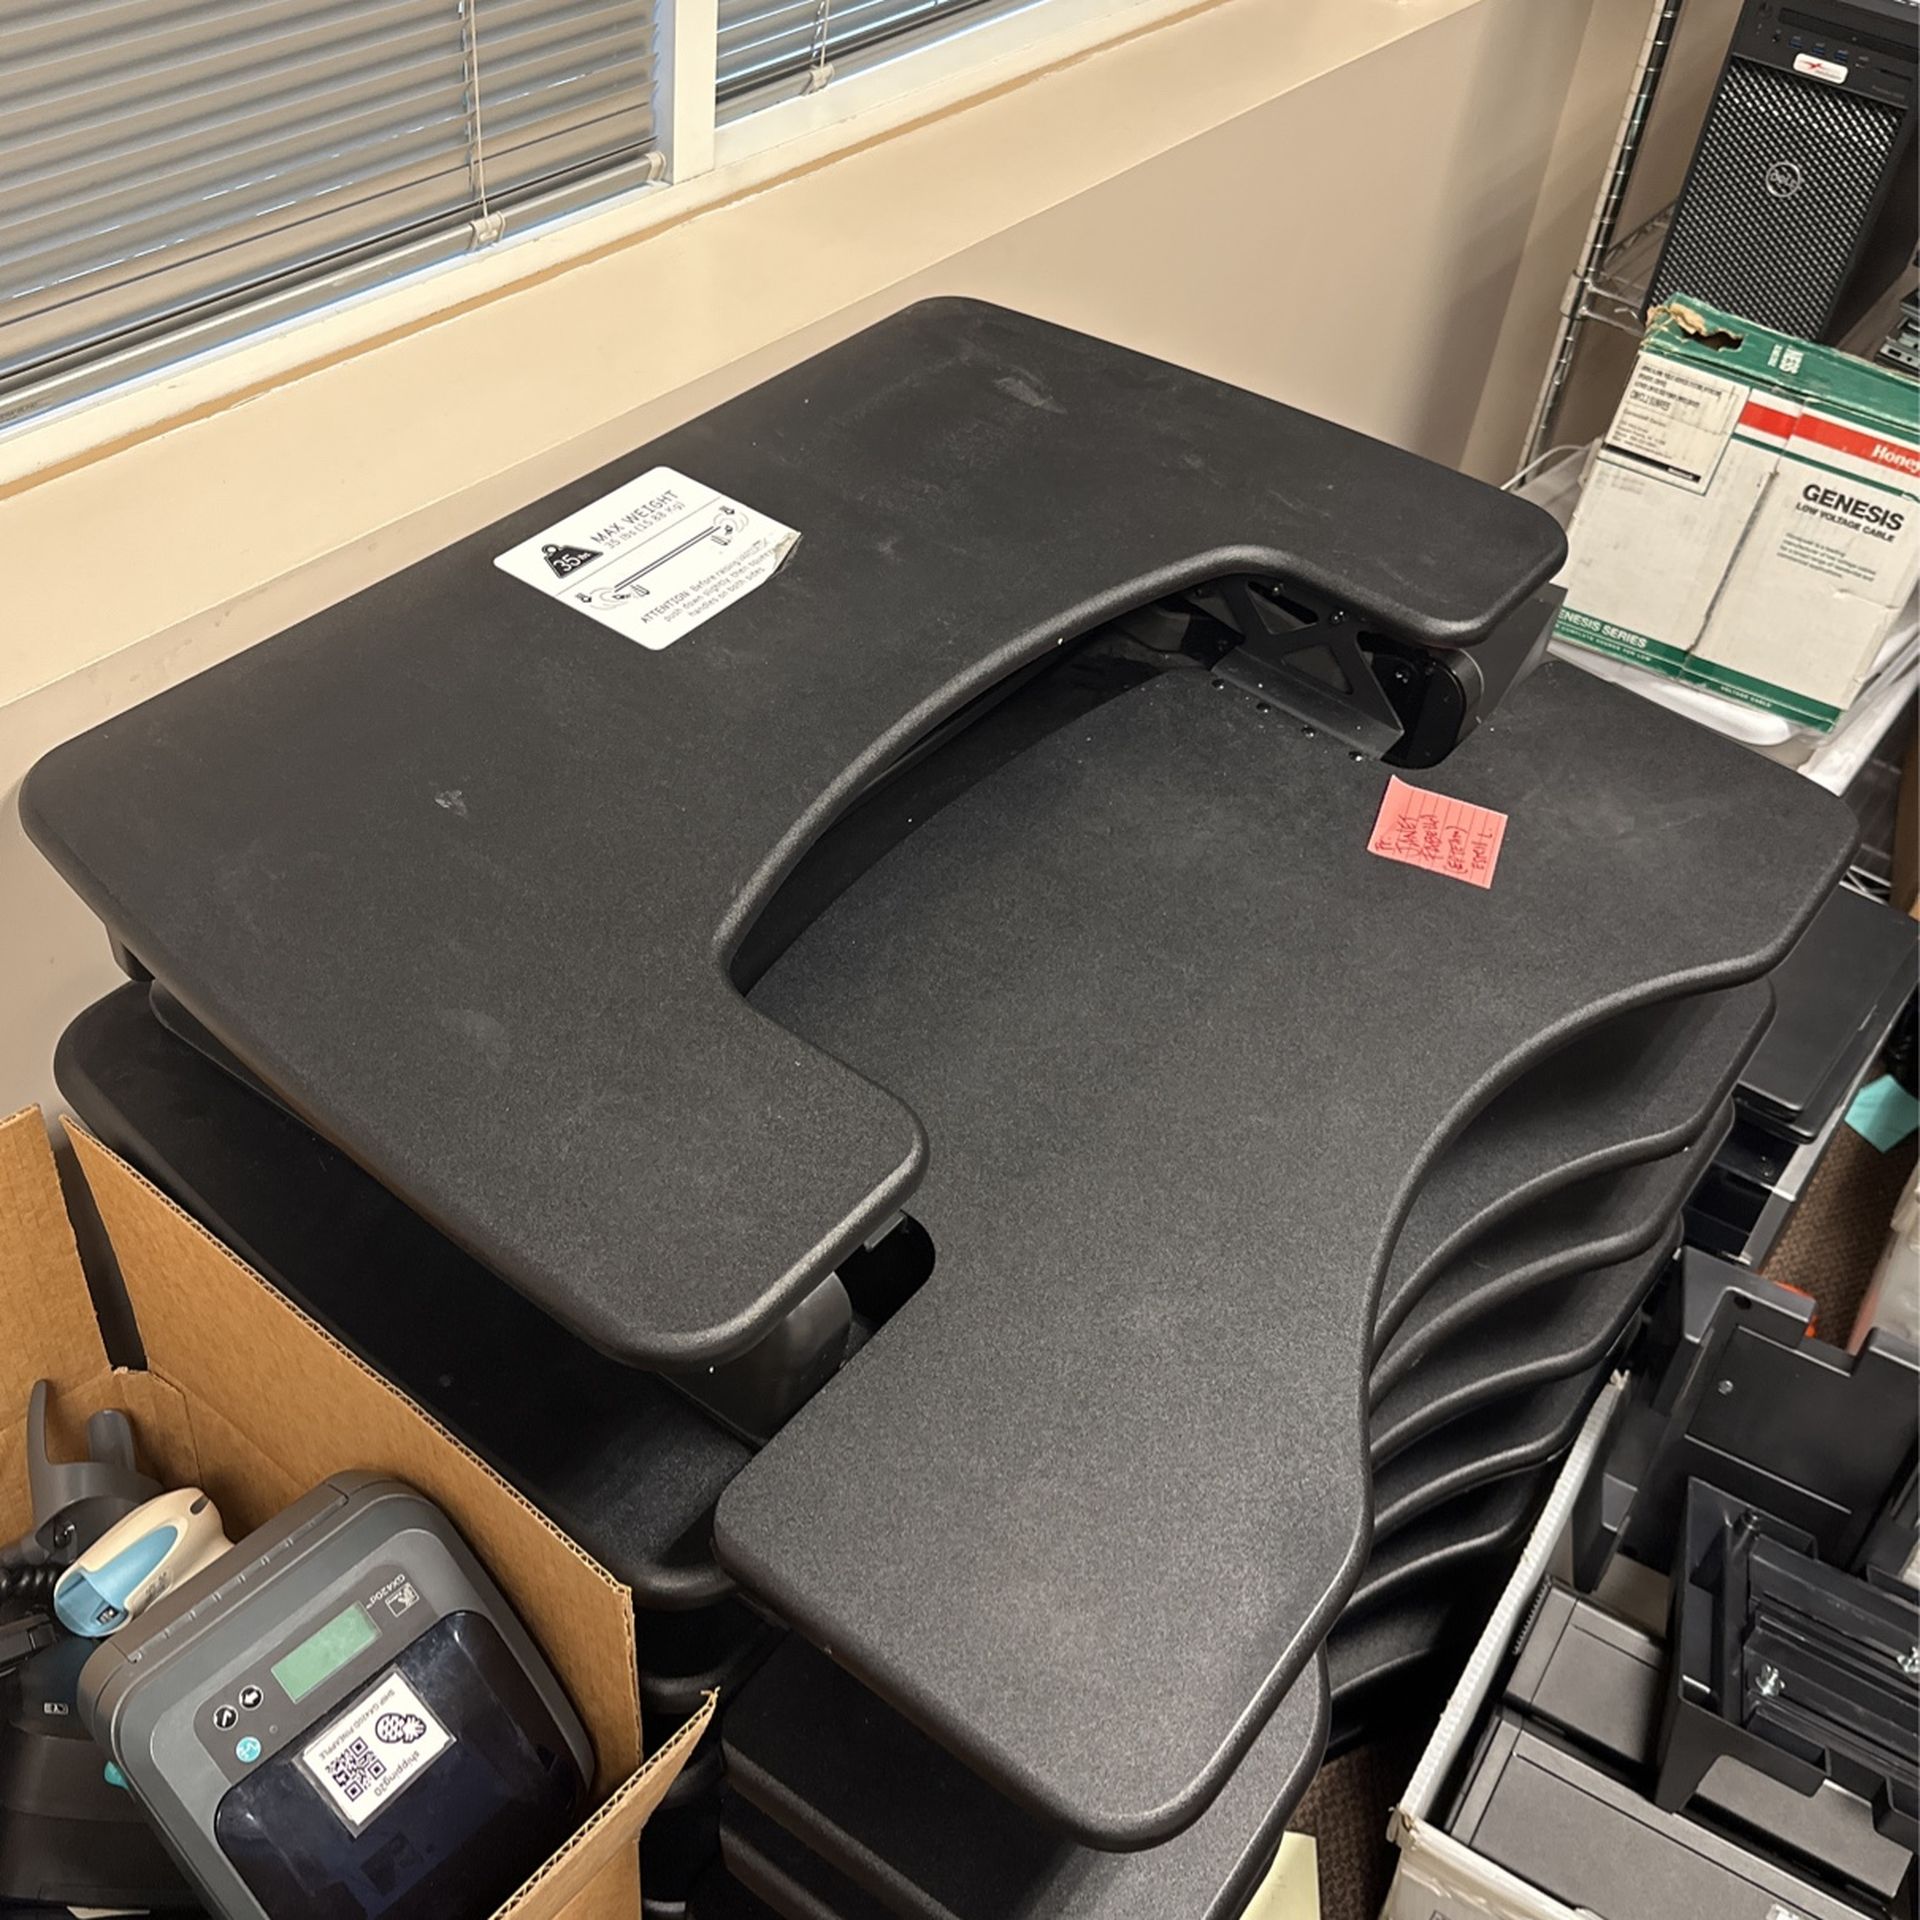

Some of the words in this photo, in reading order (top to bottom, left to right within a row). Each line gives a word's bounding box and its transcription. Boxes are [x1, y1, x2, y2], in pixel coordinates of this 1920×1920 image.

[590, 522, 624, 544] MAX
[621, 490, 678, 525] WEIGHT
[1796, 502, 1818, 515] LOW
[1820, 510, 1861, 531] VOLTAGE
[1862, 526, 1895, 543] CABLE
[1802, 484, 1905, 531] GENESIS
[553, 553, 581, 572] 35
[1602, 625, 1648, 649] SERIES
[374, 1750, 420, 1797] shipping20
